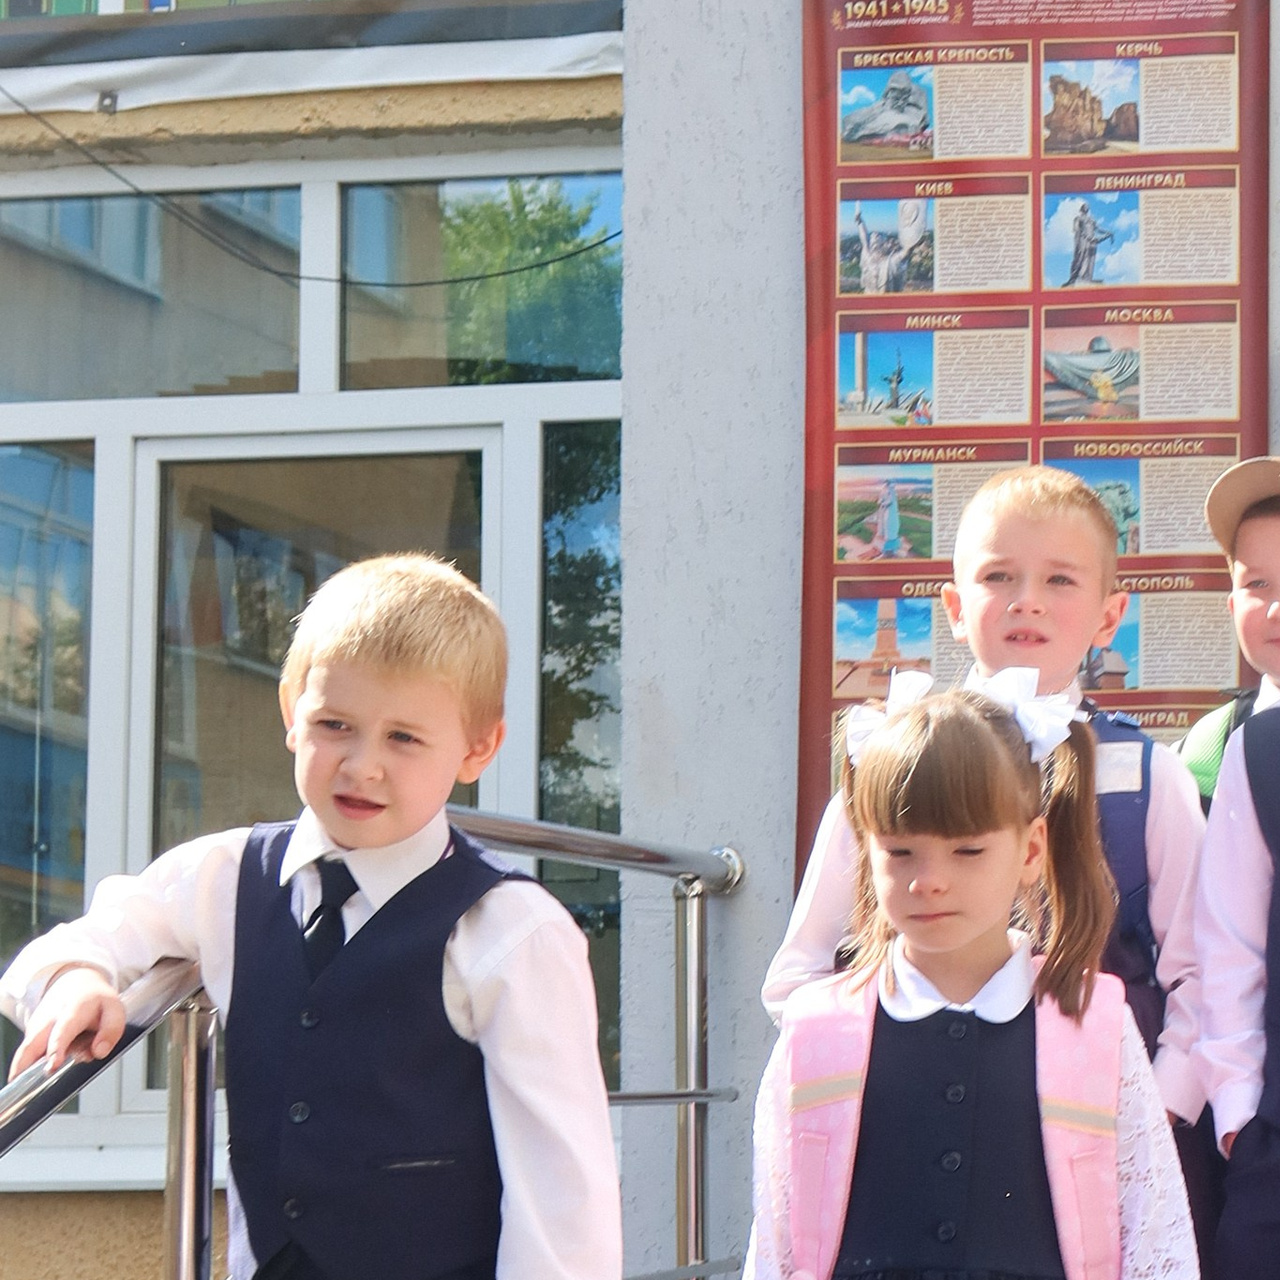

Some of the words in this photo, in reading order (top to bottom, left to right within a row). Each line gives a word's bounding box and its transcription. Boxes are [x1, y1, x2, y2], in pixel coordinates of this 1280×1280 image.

[844, 0, 889, 20] 1941
[853, 50, 934, 68] БРЕСТСКАЯ
[937, 46, 1016, 63] КРЕПОСТЬ
[1115, 41, 1164, 57] КЕРЧЬ
[914, 181, 955, 197] КИЕВ
[1093, 172, 1187, 191] ЛЕНИНГРАД
[905, 313, 963, 329] МИНСК
[1103, 307, 1175, 323] МОСКВА
[888, 446, 979, 463] МУРМАНСК
[1073, 437, 1206, 457] НОВОРОССИЙСК
[901, 581, 943, 598] ОДЕС
